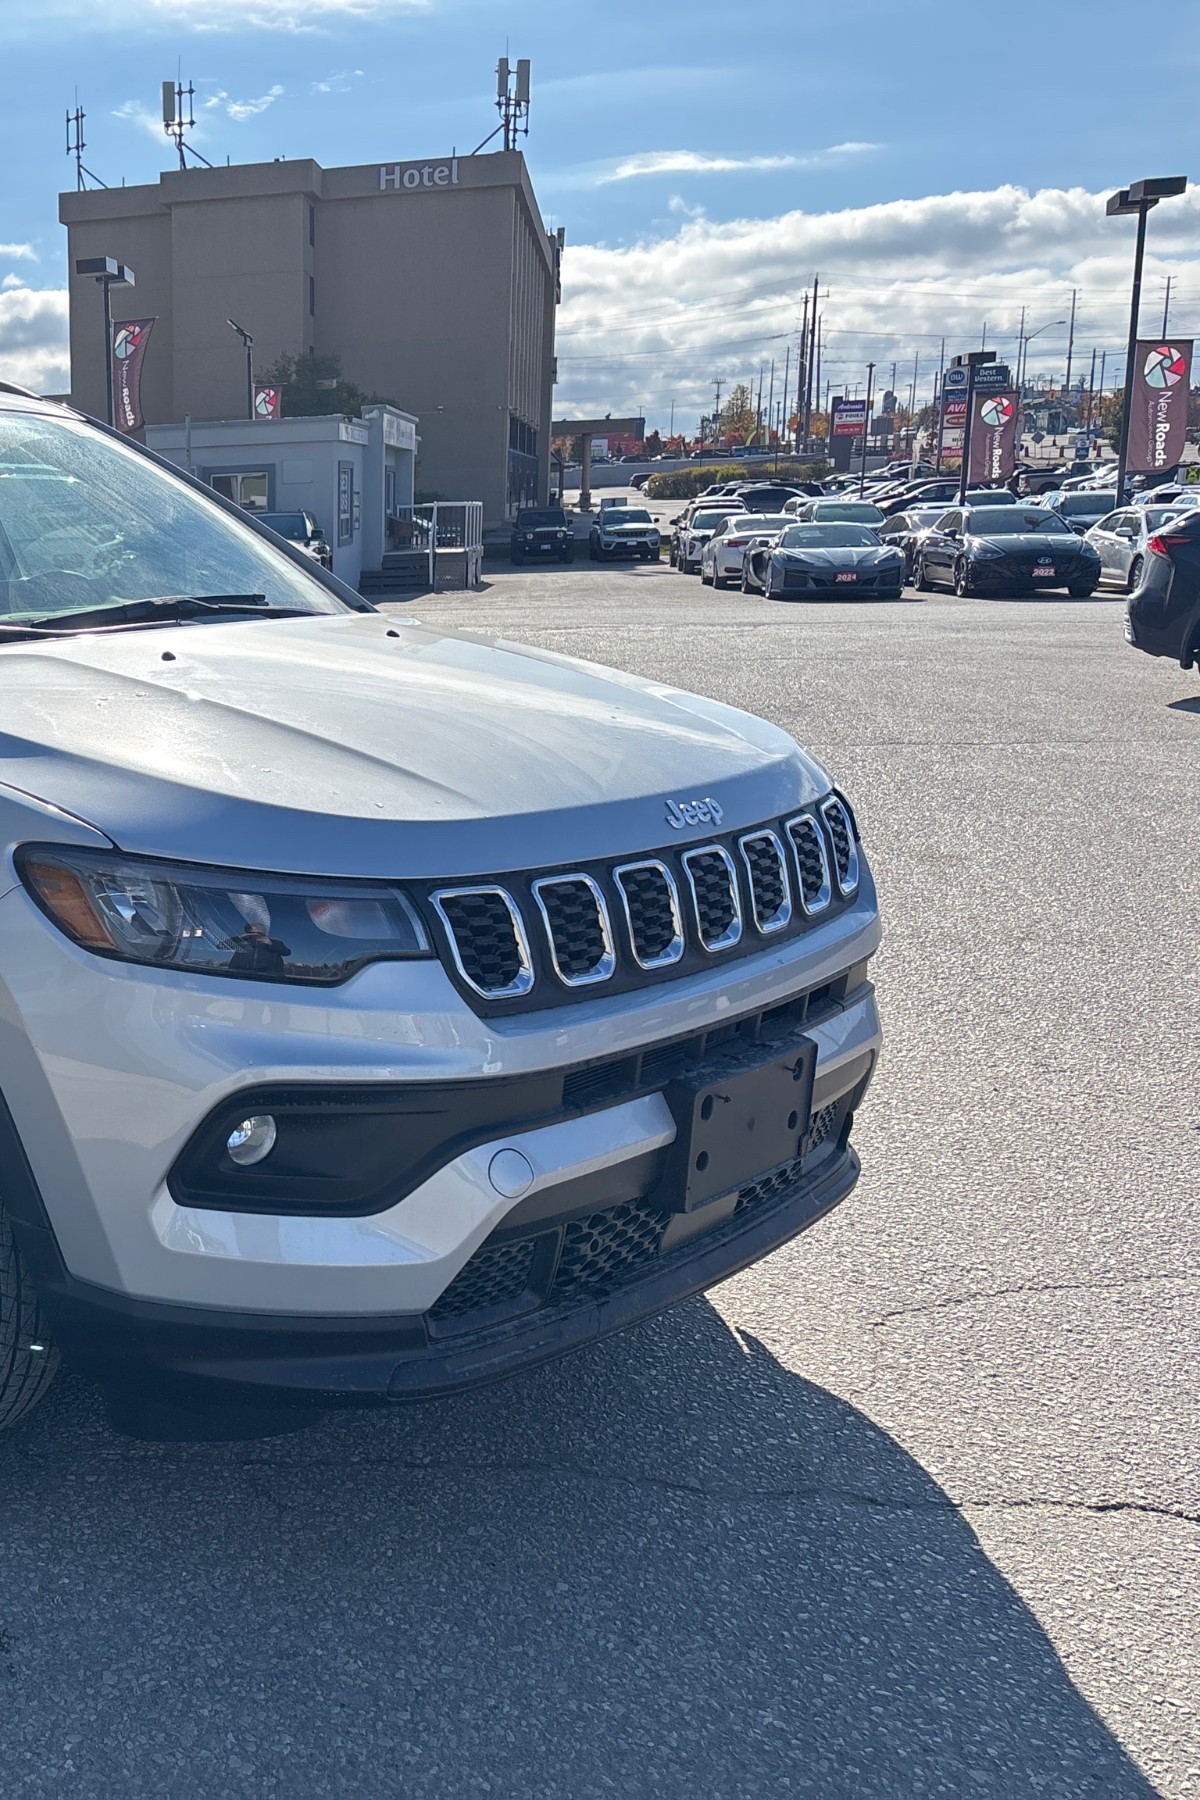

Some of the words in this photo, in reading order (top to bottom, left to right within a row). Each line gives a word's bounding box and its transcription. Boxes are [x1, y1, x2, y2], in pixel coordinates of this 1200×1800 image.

[380, 159, 459, 190] Hotel
[947, 403, 968, 413] AVI
[1155, 391, 1173, 467] NewRoads
[992, 427, 1004, 478] NewRoads
[836, 573, 857, 582] 2024
[1032, 568, 1055, 577] 2022
[664, 798, 724, 829] Jeep
